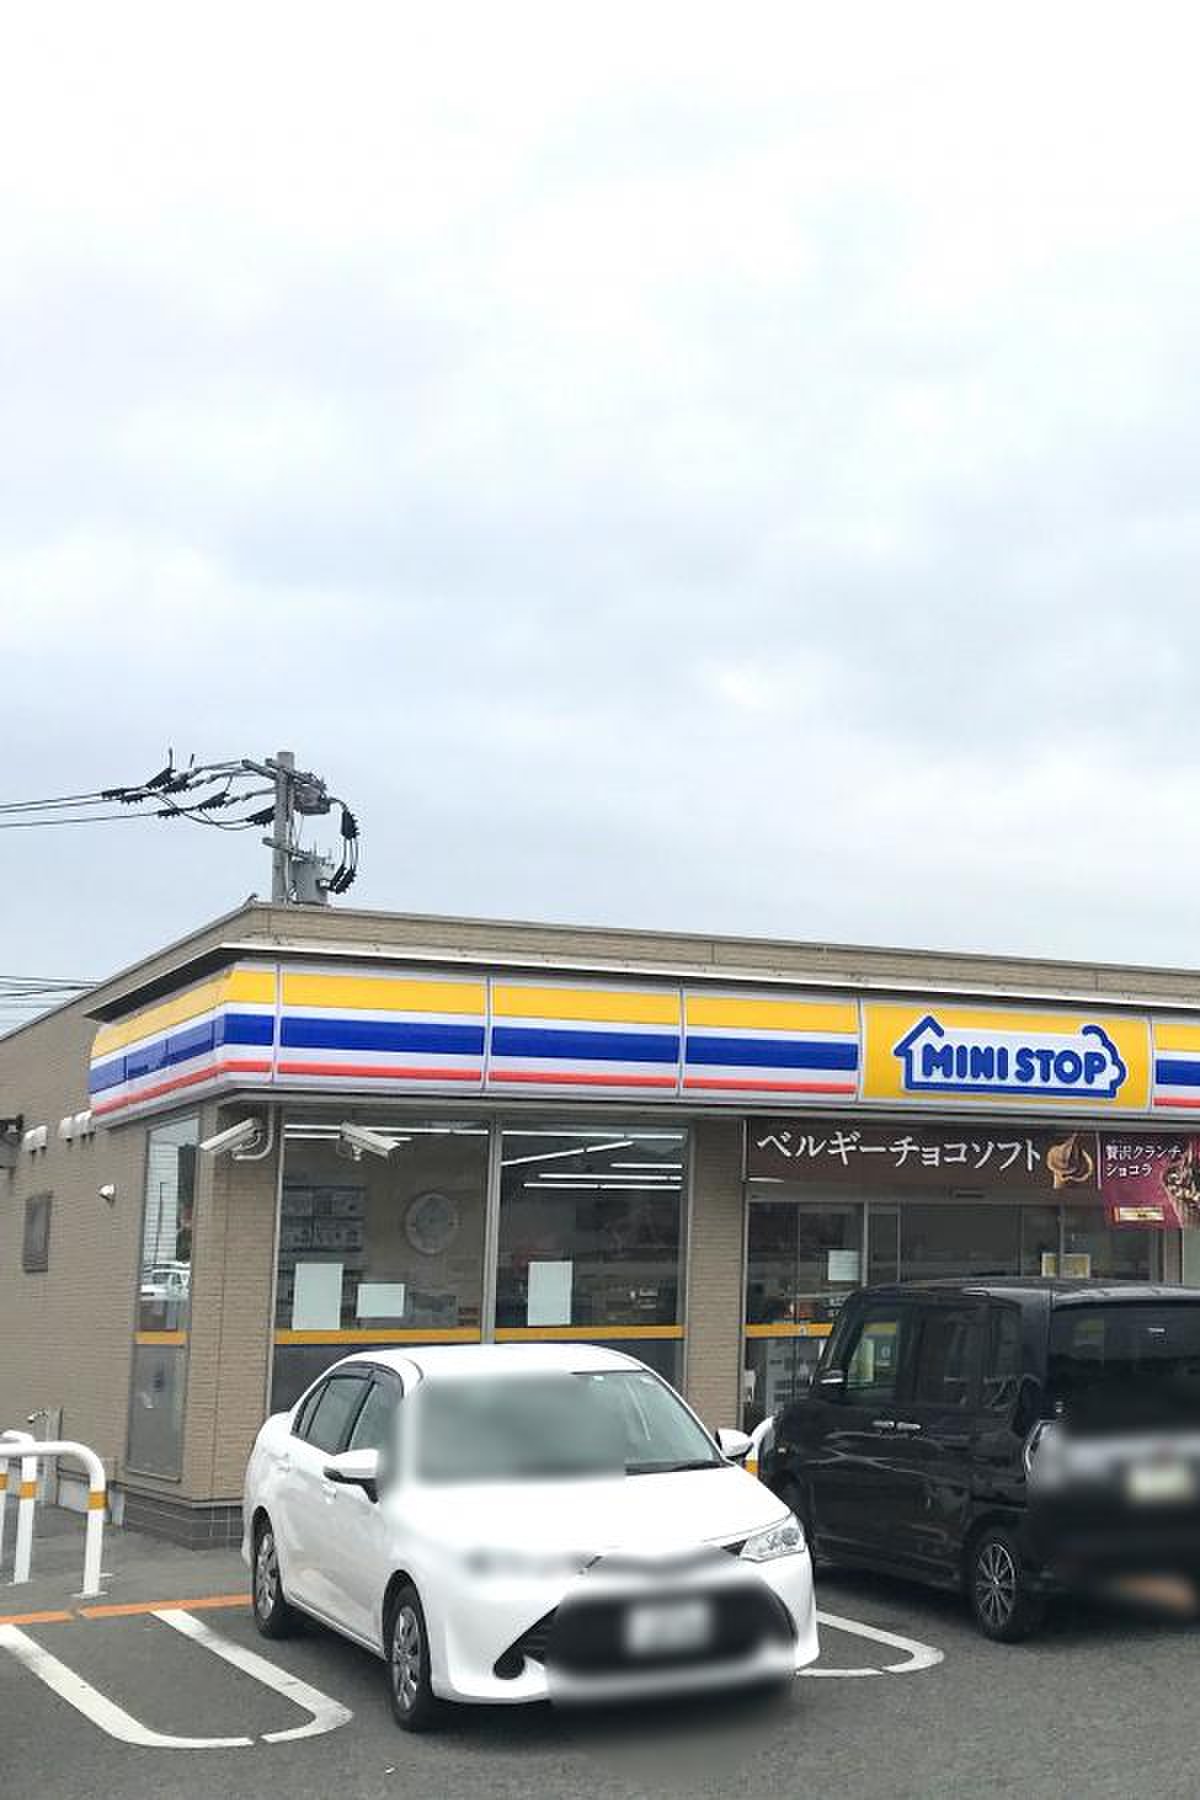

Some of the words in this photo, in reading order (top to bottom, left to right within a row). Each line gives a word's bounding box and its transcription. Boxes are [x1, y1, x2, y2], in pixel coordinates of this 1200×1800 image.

[922, 1043, 1009, 1080] MINI
[1015, 1047, 1107, 1084] STOP
[757, 1130, 1041, 1171] ベルギーチョコソフト
[1106, 1163, 1153, 1177] ショコラ
